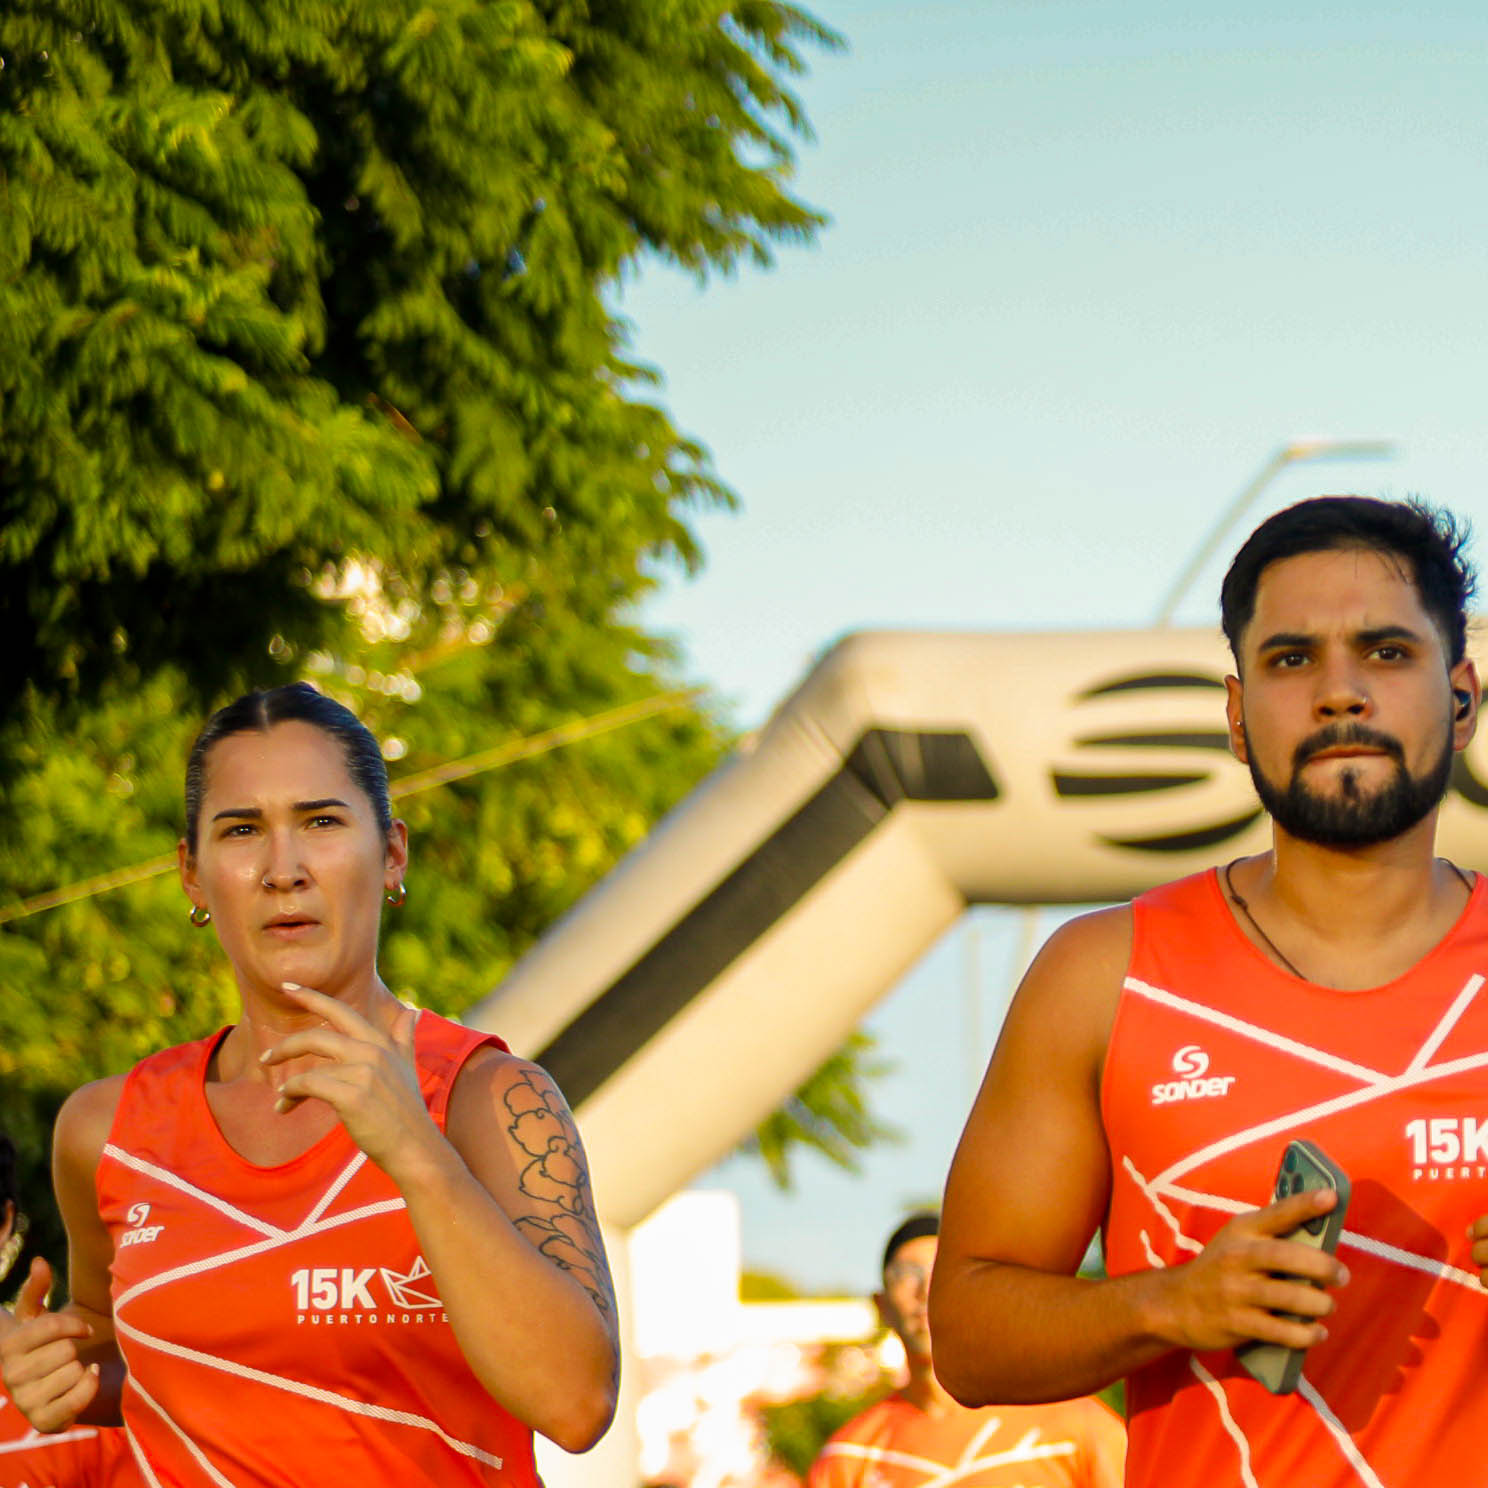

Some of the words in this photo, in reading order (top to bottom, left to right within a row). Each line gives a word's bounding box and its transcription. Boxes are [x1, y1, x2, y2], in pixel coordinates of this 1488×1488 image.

[291, 1268, 377, 1310] 15K
[297, 1315, 378, 1324] PUERTO
[386, 1313, 449, 1324] NORTE
